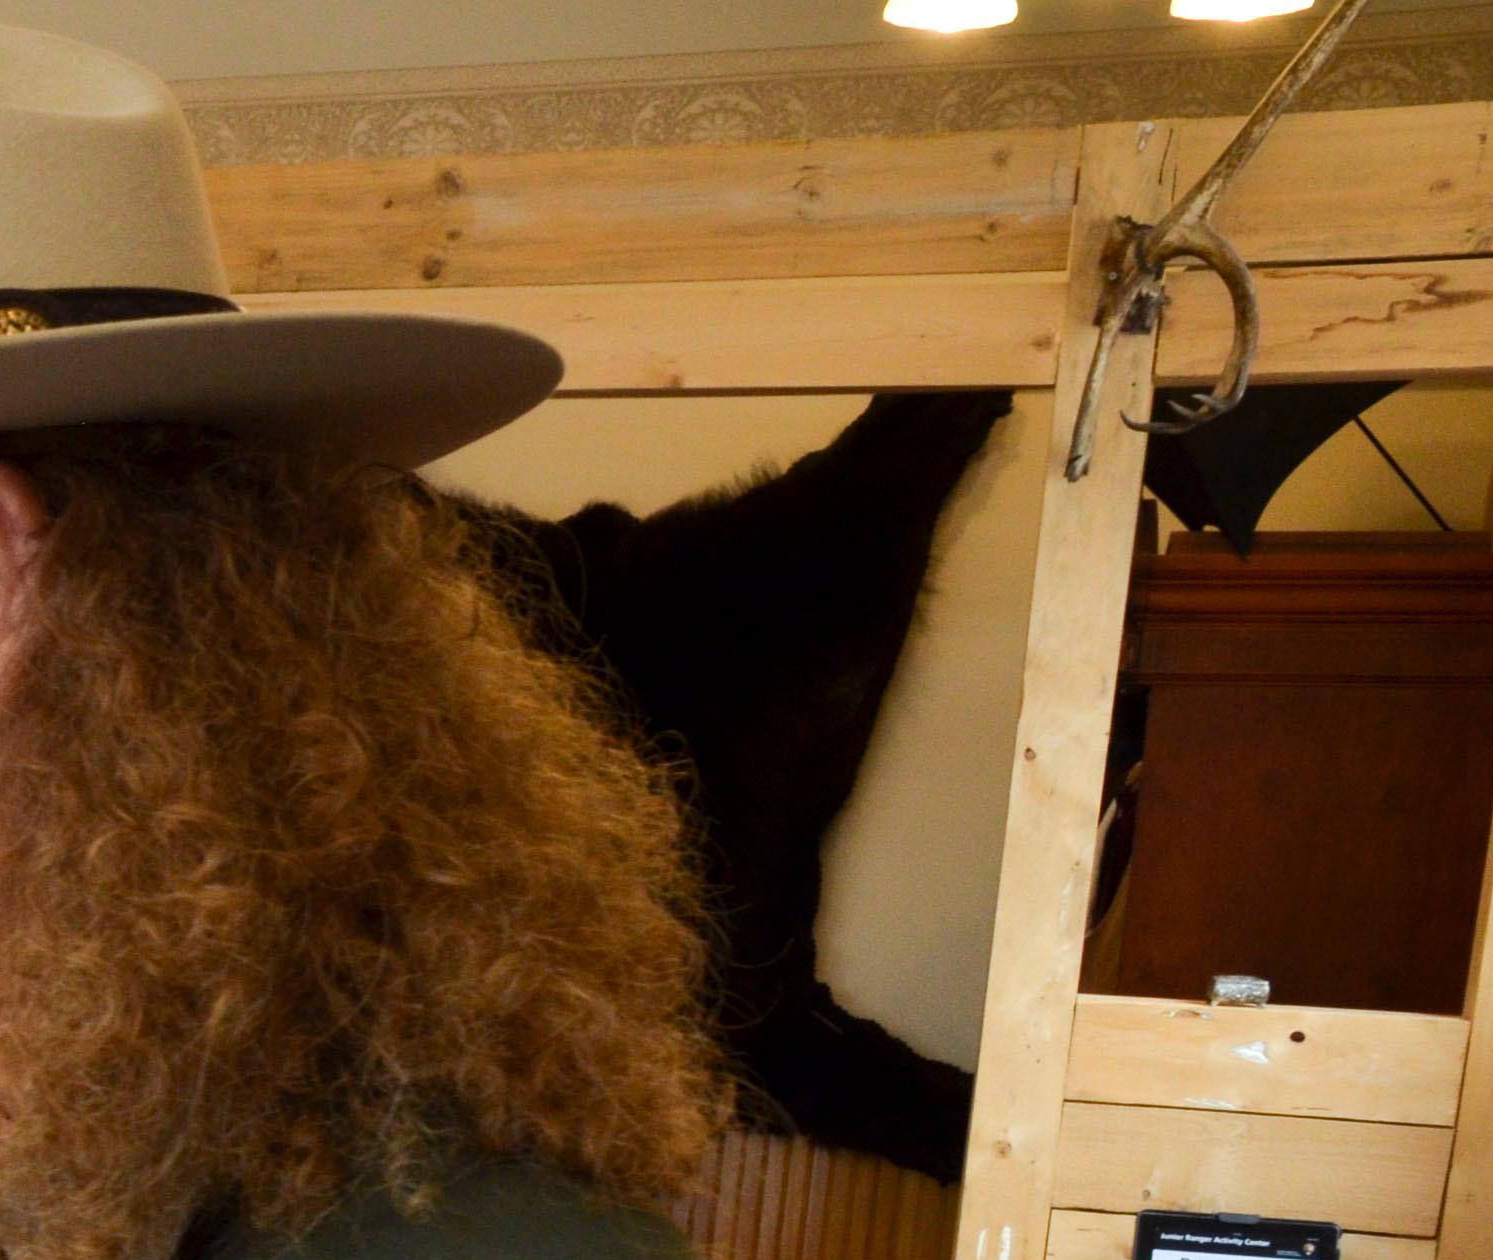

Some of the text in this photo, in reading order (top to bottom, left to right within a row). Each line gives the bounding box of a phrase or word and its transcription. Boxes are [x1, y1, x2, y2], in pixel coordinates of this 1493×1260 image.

[1185, 1233, 1212, 1244] Ranger
[1213, 1236, 1244, 1246] Activity
[1244, 1238, 1271, 1248] Center
